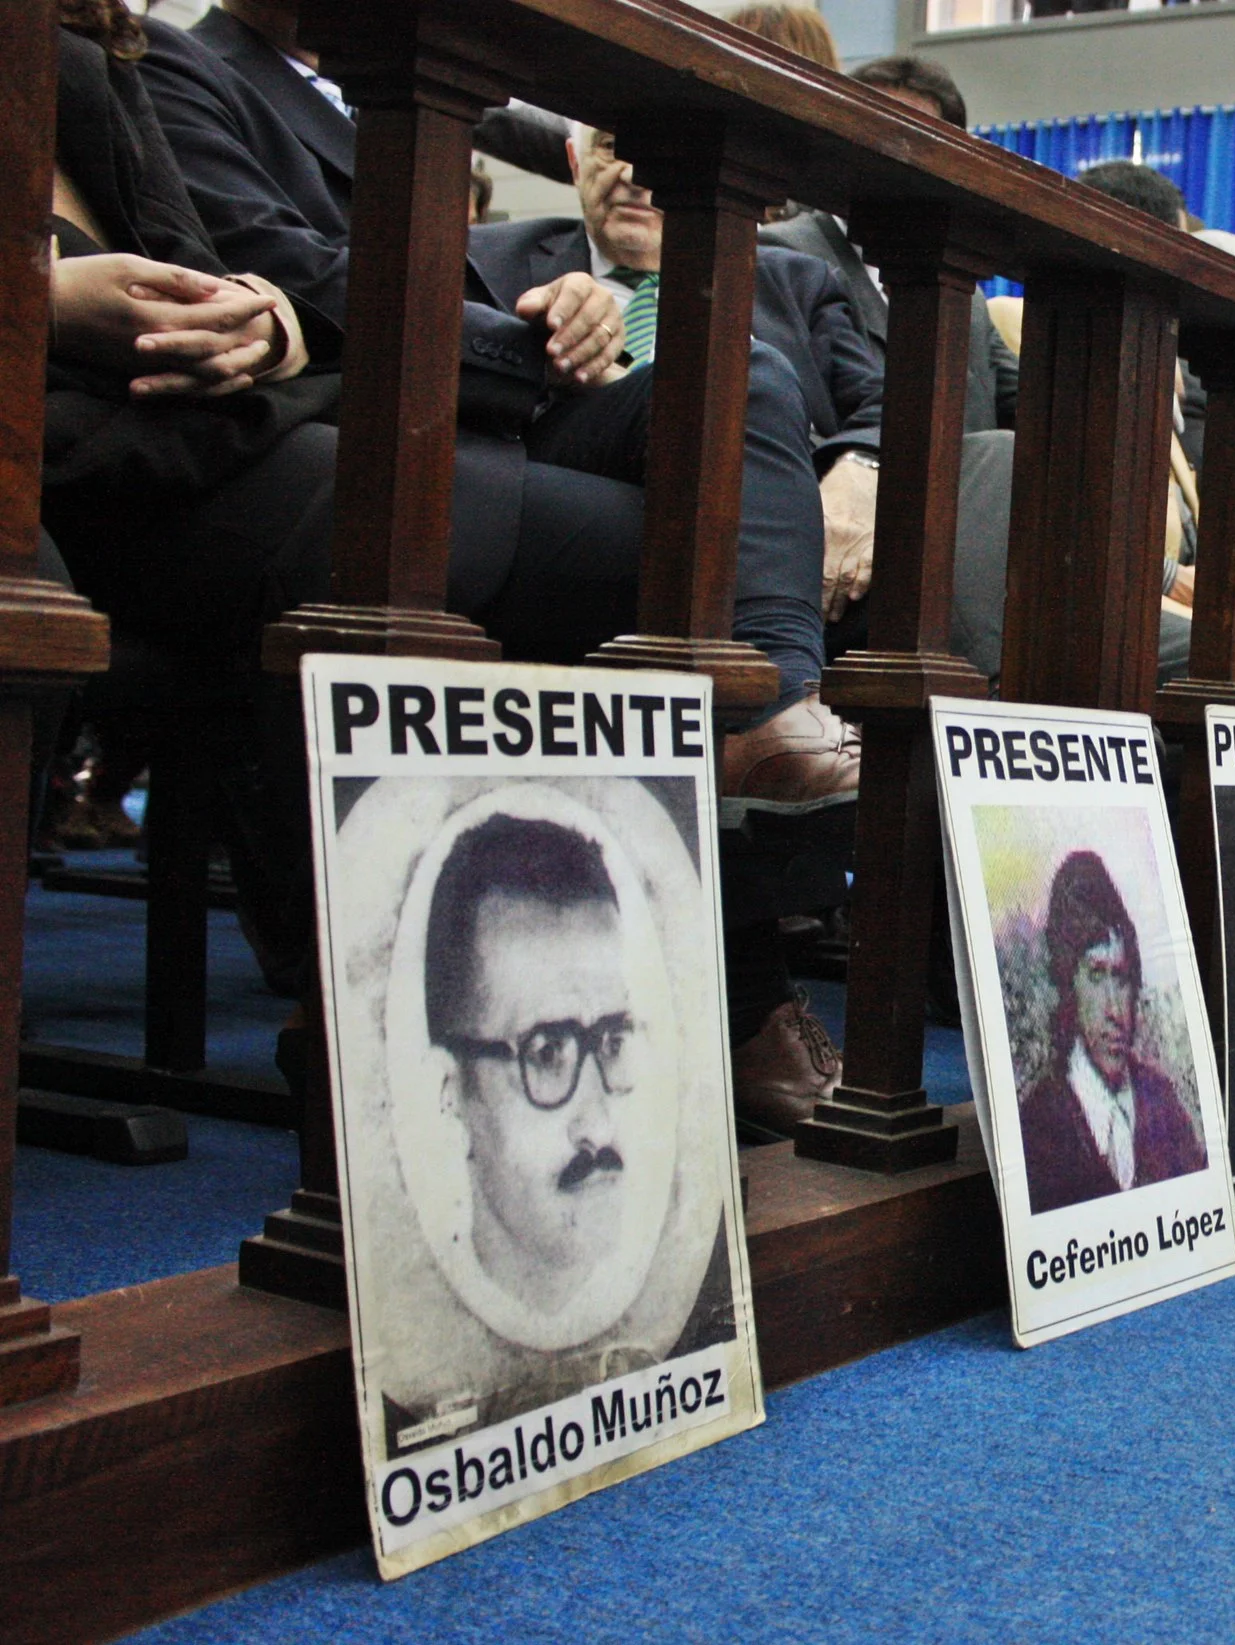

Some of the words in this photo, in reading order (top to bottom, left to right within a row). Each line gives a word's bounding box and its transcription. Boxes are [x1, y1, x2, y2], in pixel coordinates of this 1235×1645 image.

[330, 682, 705, 758] PRESENTE
[945, 725, 1154, 785] PRESENTE
[1026, 1229, 1149, 1289] Ceferino
[1156, 1208, 1226, 1251] López
[381, 1416, 585, 1528] Osbaldo
[590, 1368, 725, 1447] Muñoz
